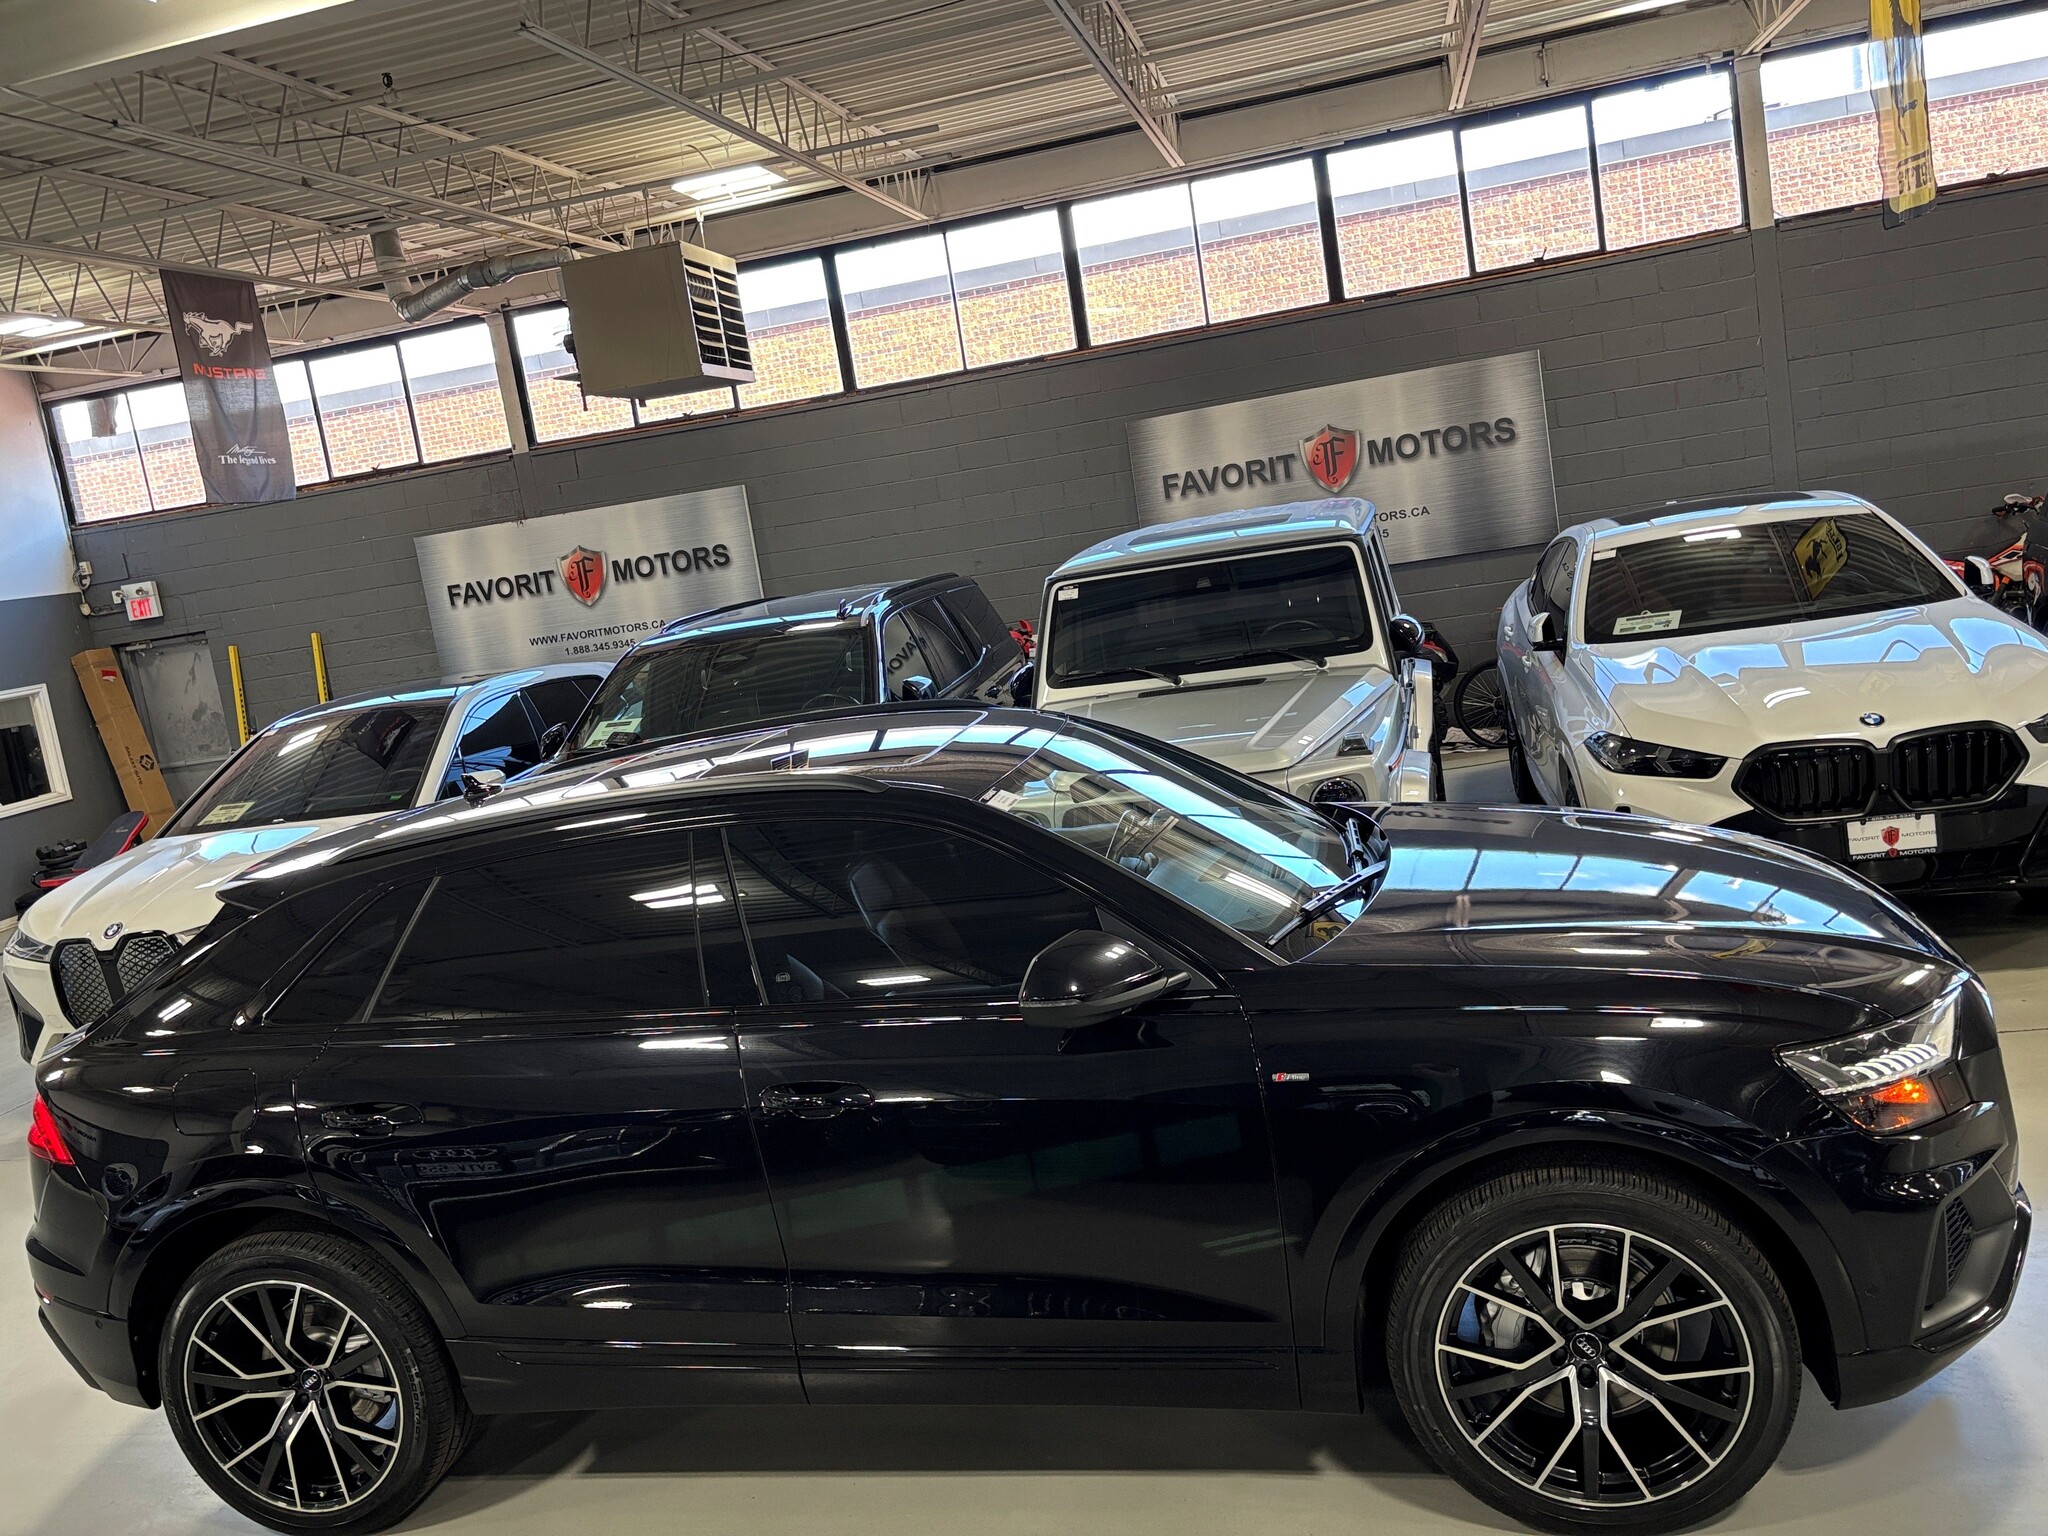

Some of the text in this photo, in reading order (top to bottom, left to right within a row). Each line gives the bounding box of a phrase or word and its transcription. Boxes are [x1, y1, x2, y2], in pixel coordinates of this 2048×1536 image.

[193, 363, 266, 380] MUSTANG
[218, 454, 238, 465] The
[258, 455, 277, 465] lives
[1162, 454, 1296, 499] FAVORIT
[1367, 417, 1517, 466] MOTORS
[447, 570, 556, 606] FAVORIT
[612, 543, 731, 583] MOTORS
[130, 598, 152, 618] EXIT
[529, 619, 667, 647] WWW.FAVORITMOTORS.CA
[564, 638, 636, 656] 1.888.345.9345
[1901, 830, 1936, 838] MOTORS
[1852, 848, 1936, 860] FAVORIT MOTORS
